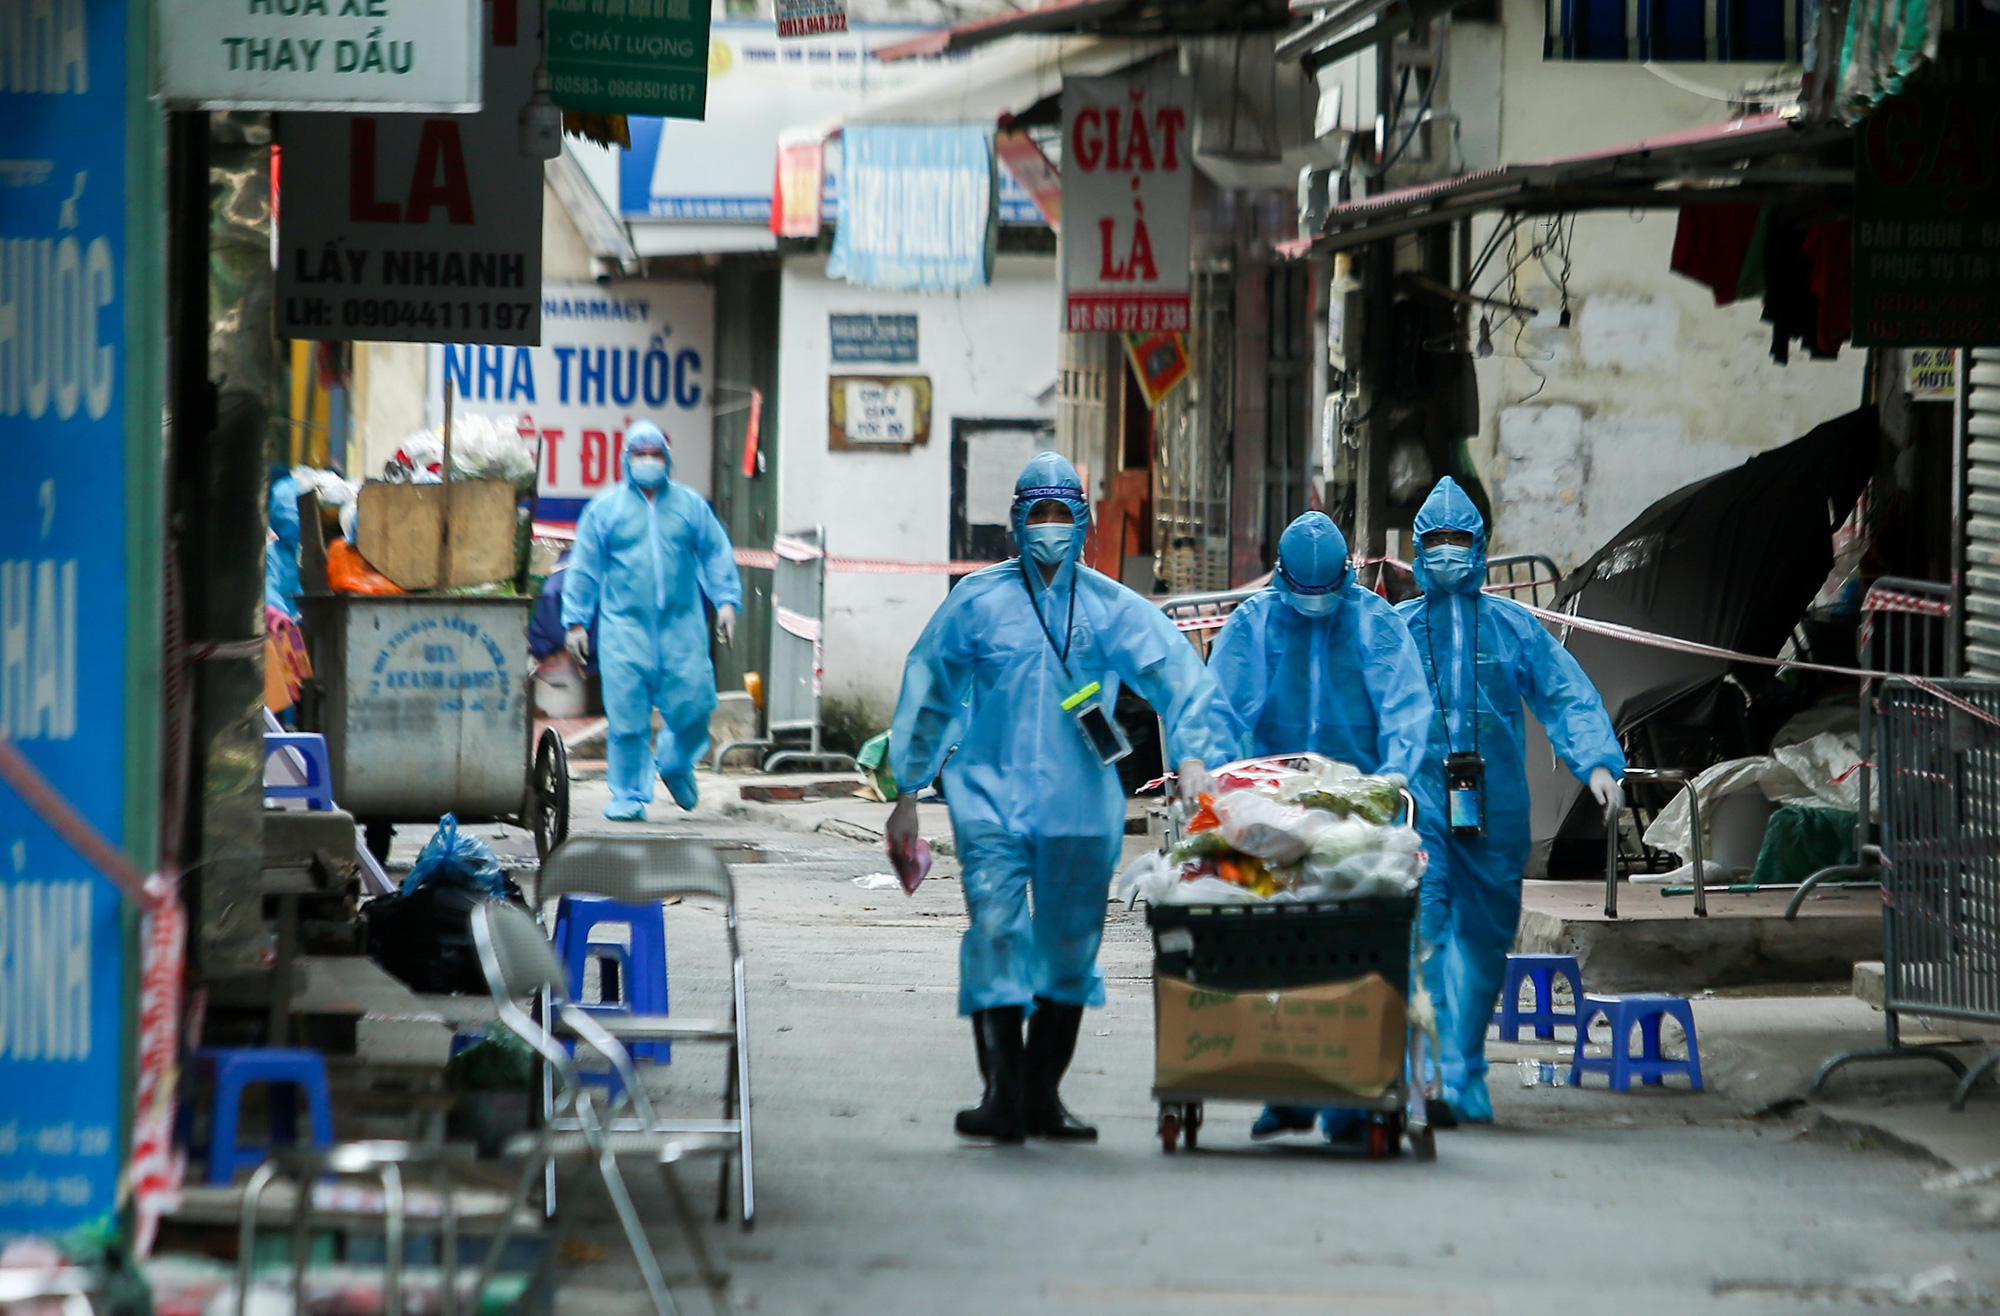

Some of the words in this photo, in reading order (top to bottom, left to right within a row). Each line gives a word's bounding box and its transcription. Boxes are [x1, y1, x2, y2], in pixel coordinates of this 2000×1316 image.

[221, 37, 324, 73] THAY
[1071, 87, 1186, 192] GIẶT
[294, 236, 369, 284] LẤY
[382, 250, 525, 288] NHANH
[1098, 197, 1159, 282] LÀ
[285, 298, 332, 327] LH:
[342, 299, 532, 331] 0904411197
[553, 322, 702, 410] THUỐC
